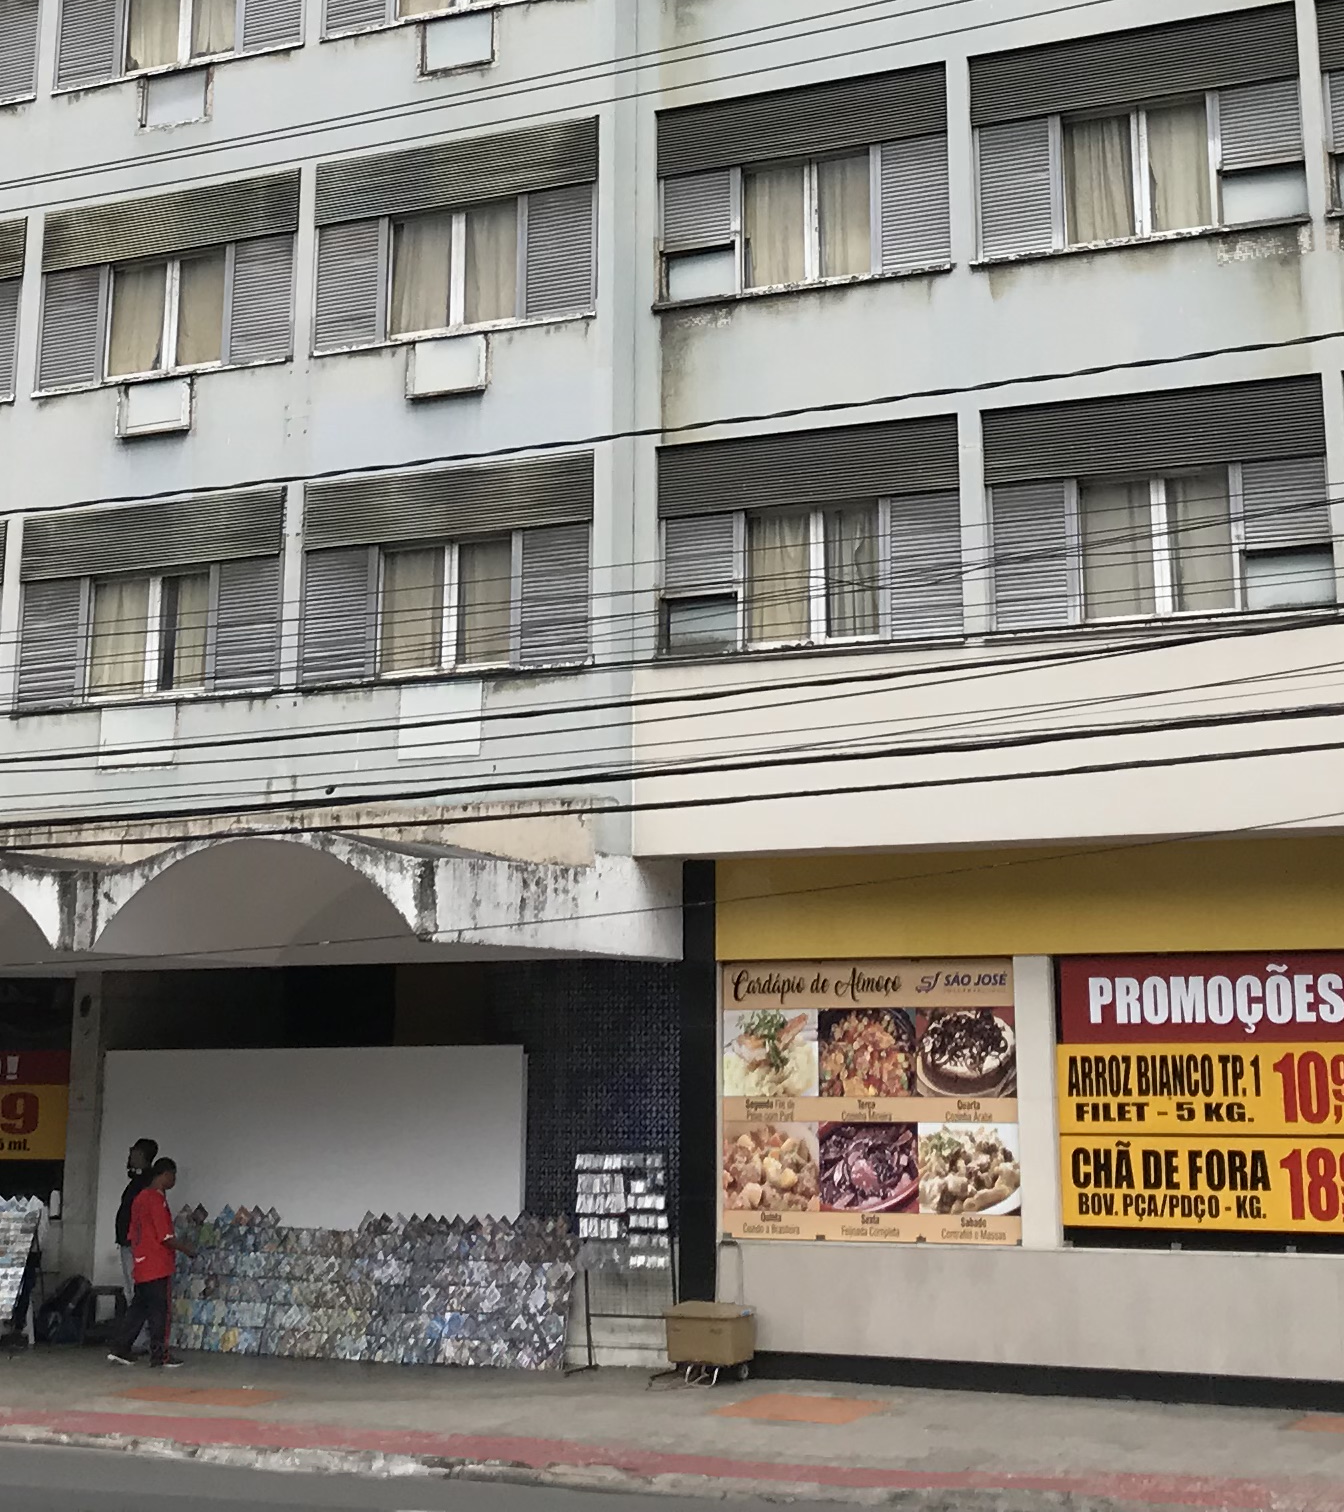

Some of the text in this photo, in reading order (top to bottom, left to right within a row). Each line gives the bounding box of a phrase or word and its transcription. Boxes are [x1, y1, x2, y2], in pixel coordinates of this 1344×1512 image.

[732, 969, 805, 1005] Cardápio
[834, 967, 902, 1002] Almoço
[974, 971, 1008, 986] JOSÉ
[1067, 1055, 1132, 1097] ARROZ
[1218, 1054, 1247, 1096] TP.
[1249, 1054, 1261, 1097] 1
[1075, 1101, 1150, 1122] FILET
[1176, 1101, 1196, 1122] 5
[1203, 1101, 1254, 1122] KG.
[1071, 1140, 1272, 1192] CHÃ DE FORA
[1078, 1192, 1119, 1216] BOV.
[1236, 1195, 1267, 1219] KG.
